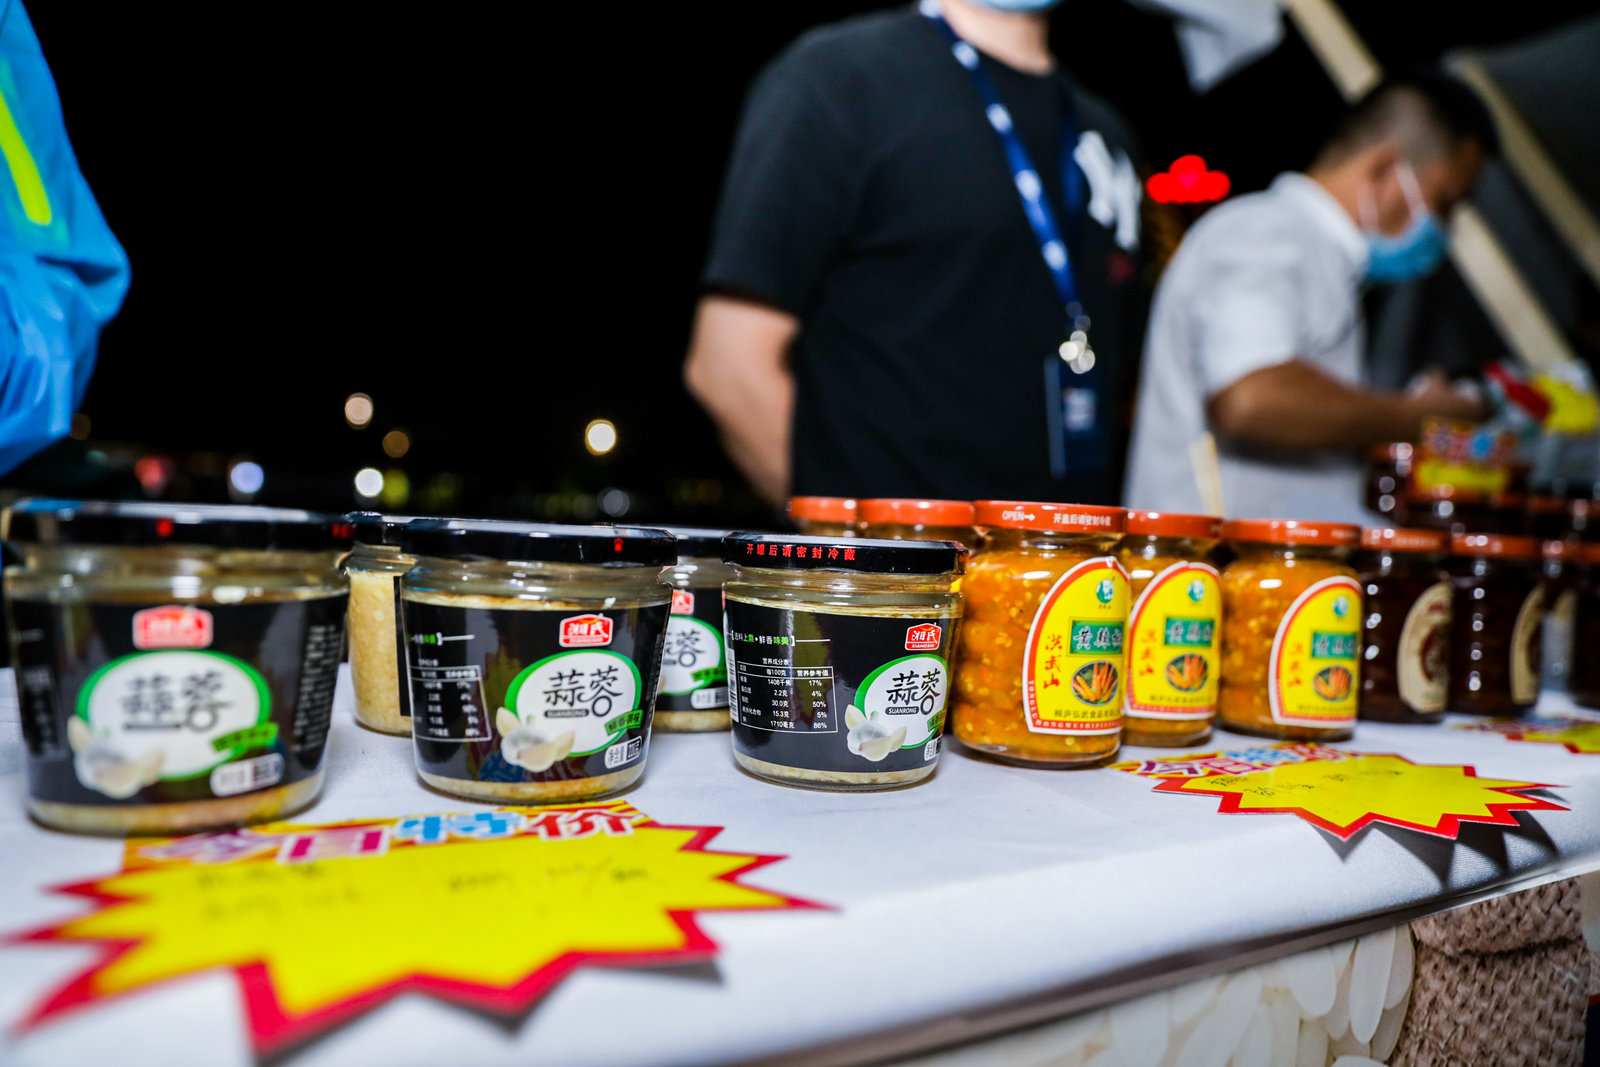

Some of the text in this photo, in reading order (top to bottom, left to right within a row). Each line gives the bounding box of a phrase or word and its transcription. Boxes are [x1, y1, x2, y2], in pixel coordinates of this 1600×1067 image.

[1002, 510, 1025, 521] OPEN
[746, 543, 856, 561] 开罐后请密封冷藏
[911, 629, 938, 643] 湘氏
[796, 669, 829, 678] 营养参考值
[542, 665, 624, 718] 蒜蓉
[811, 690, 823, 698] 4%
[886, 668, 941, 716] 蒜蓉
[816, 711, 828, 719] 5%
[888, 707, 917, 716] SUANRONG
